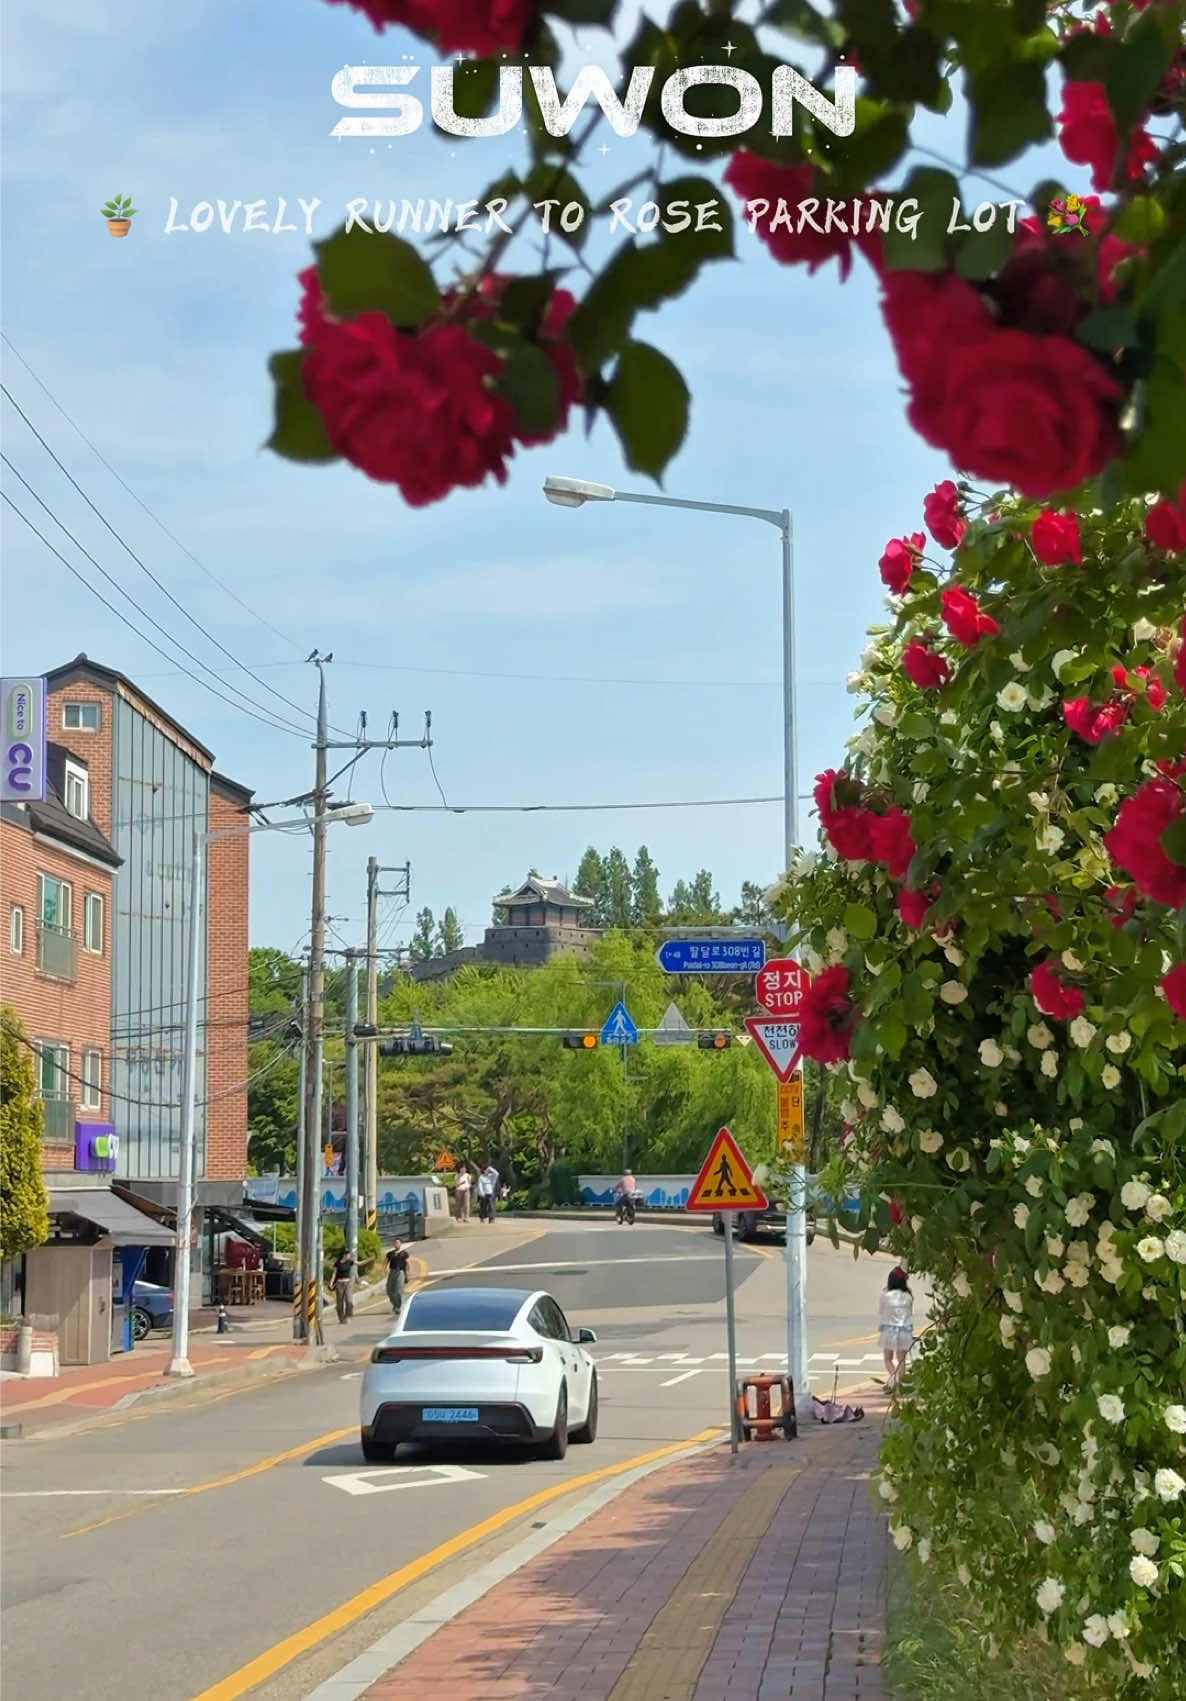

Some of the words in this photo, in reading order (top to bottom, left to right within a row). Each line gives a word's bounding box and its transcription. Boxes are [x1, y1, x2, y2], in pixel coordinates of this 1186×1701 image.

[16, 693, 26, 716] Nice
[16, 718, 24, 731] to
[8, 743, 33, 792] CU
[763, 970, 801, 990] 정지
[765, 991, 804, 1007] STOP
[769, 1039, 796, 1050] SLOW
